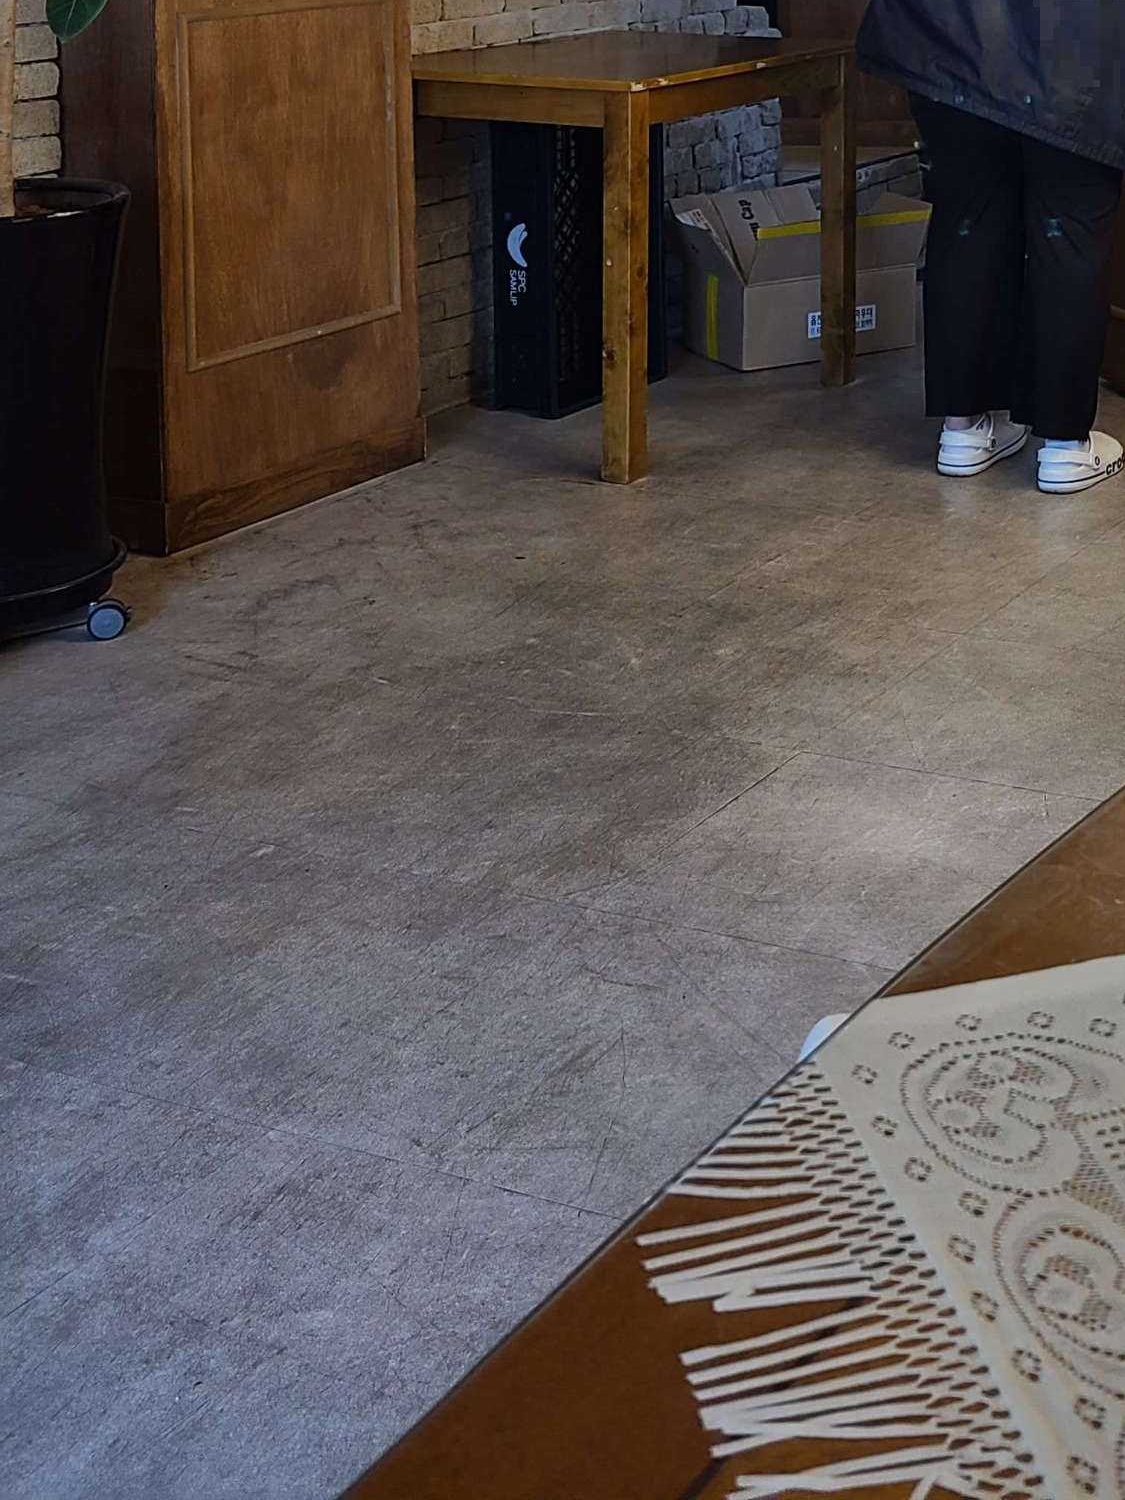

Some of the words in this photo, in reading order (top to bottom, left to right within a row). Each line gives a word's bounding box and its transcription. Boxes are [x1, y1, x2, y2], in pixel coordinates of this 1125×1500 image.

[738, 199, 755, 220] Cap
[509, 269, 517, 307] SAMLIP
[518, 270, 526, 294] SPC
[1106, 452, 1125, 476] croc
